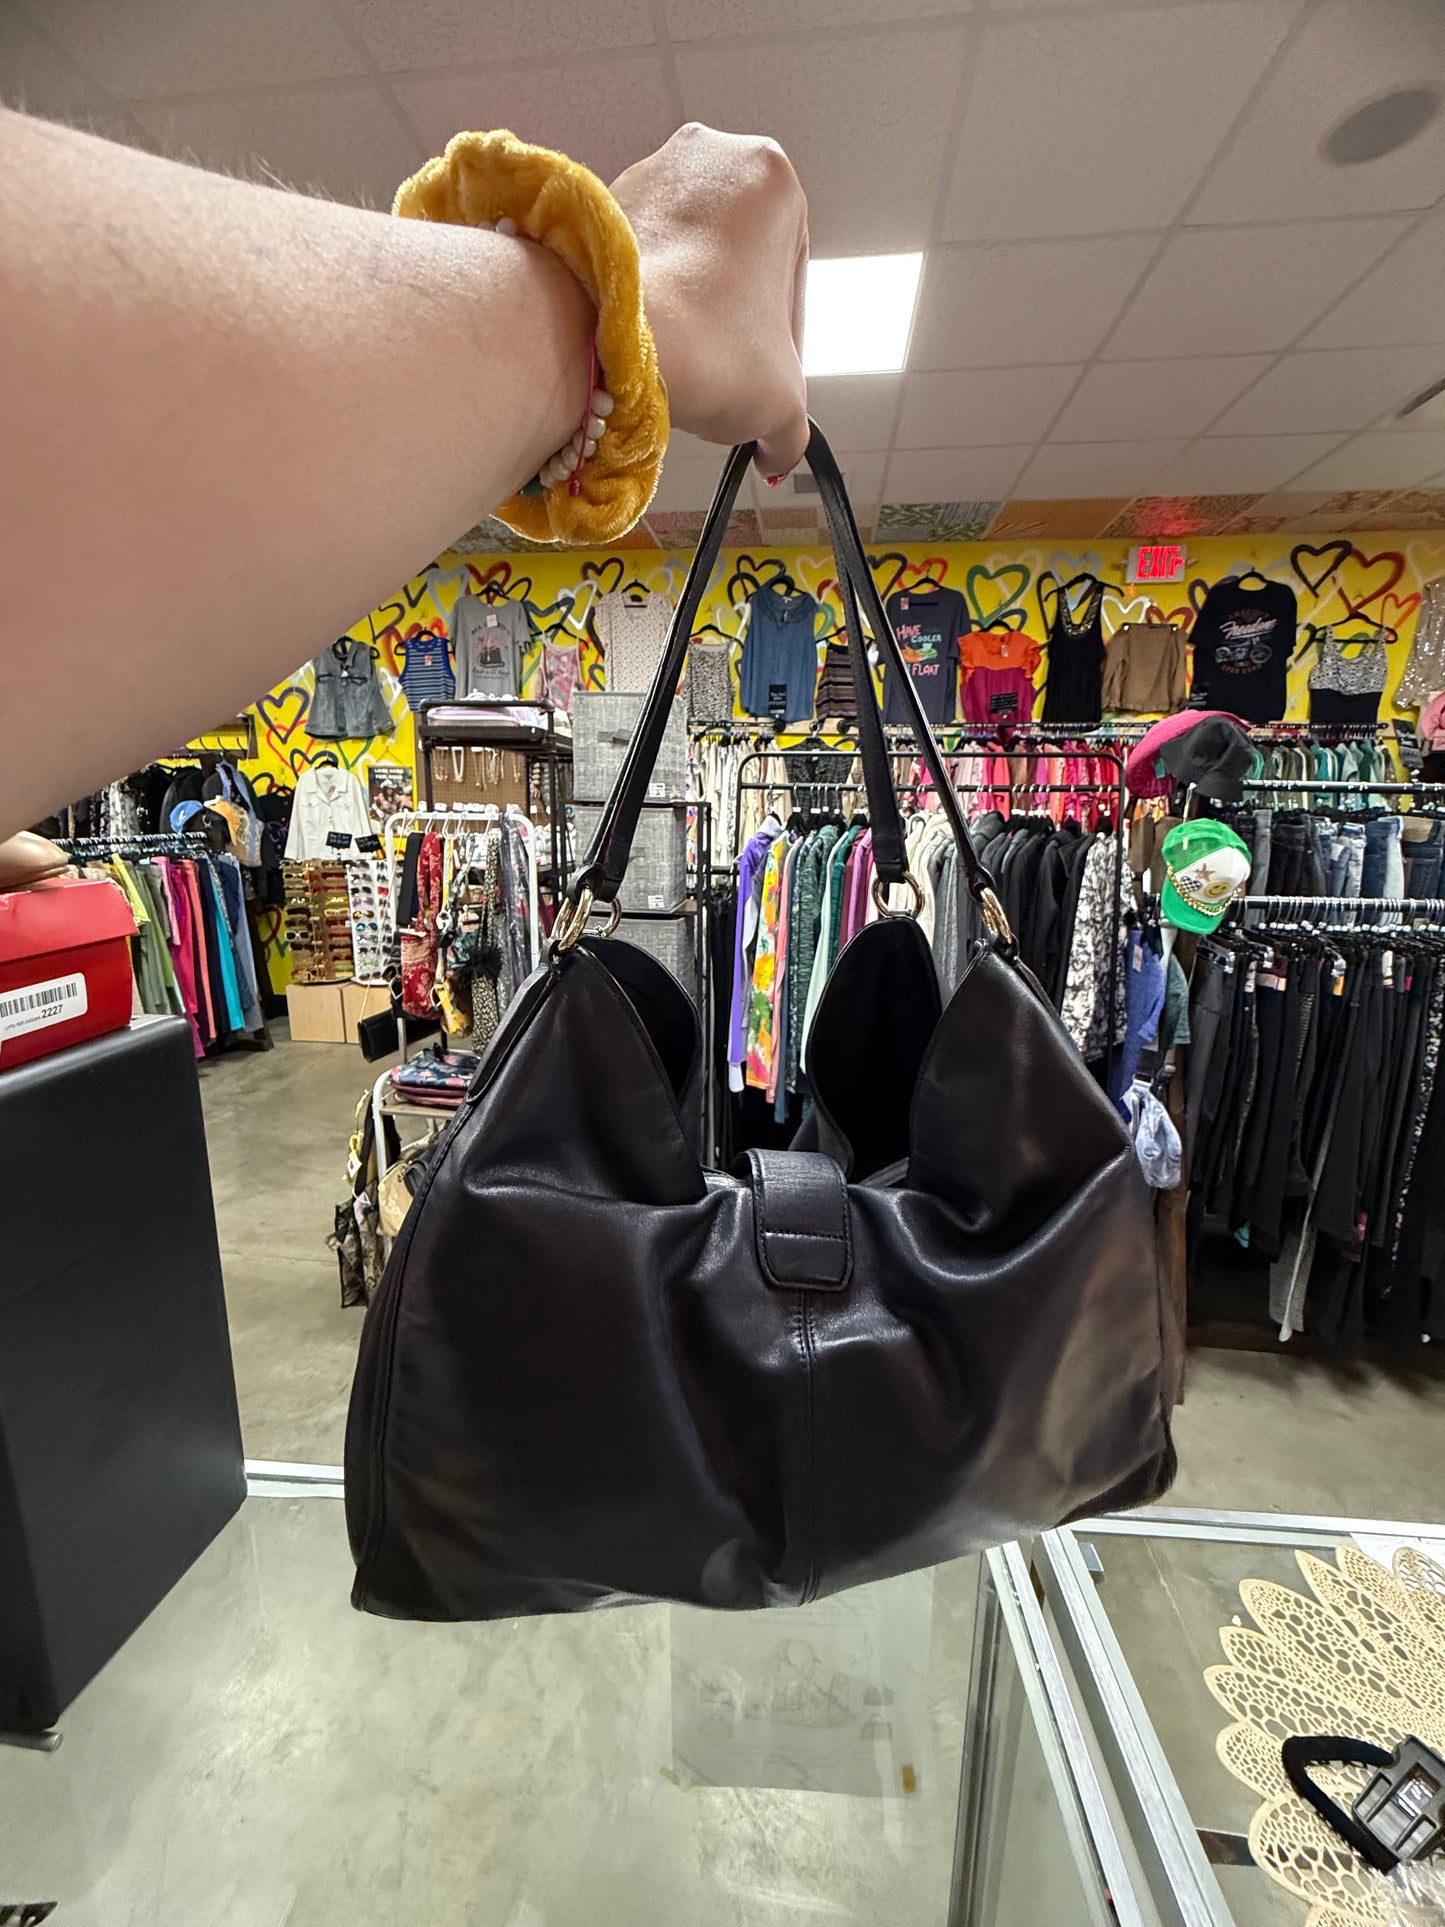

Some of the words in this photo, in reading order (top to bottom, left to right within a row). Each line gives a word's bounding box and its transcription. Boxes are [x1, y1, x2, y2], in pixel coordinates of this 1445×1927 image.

[1137, 546, 1181, 579] EXIT
[896, 624, 922, 641] HAVE
[911, 634, 942, 644] COOLER
[912, 664, 940, 676] FLOAT
[41, 1004, 63, 1018] 2227
